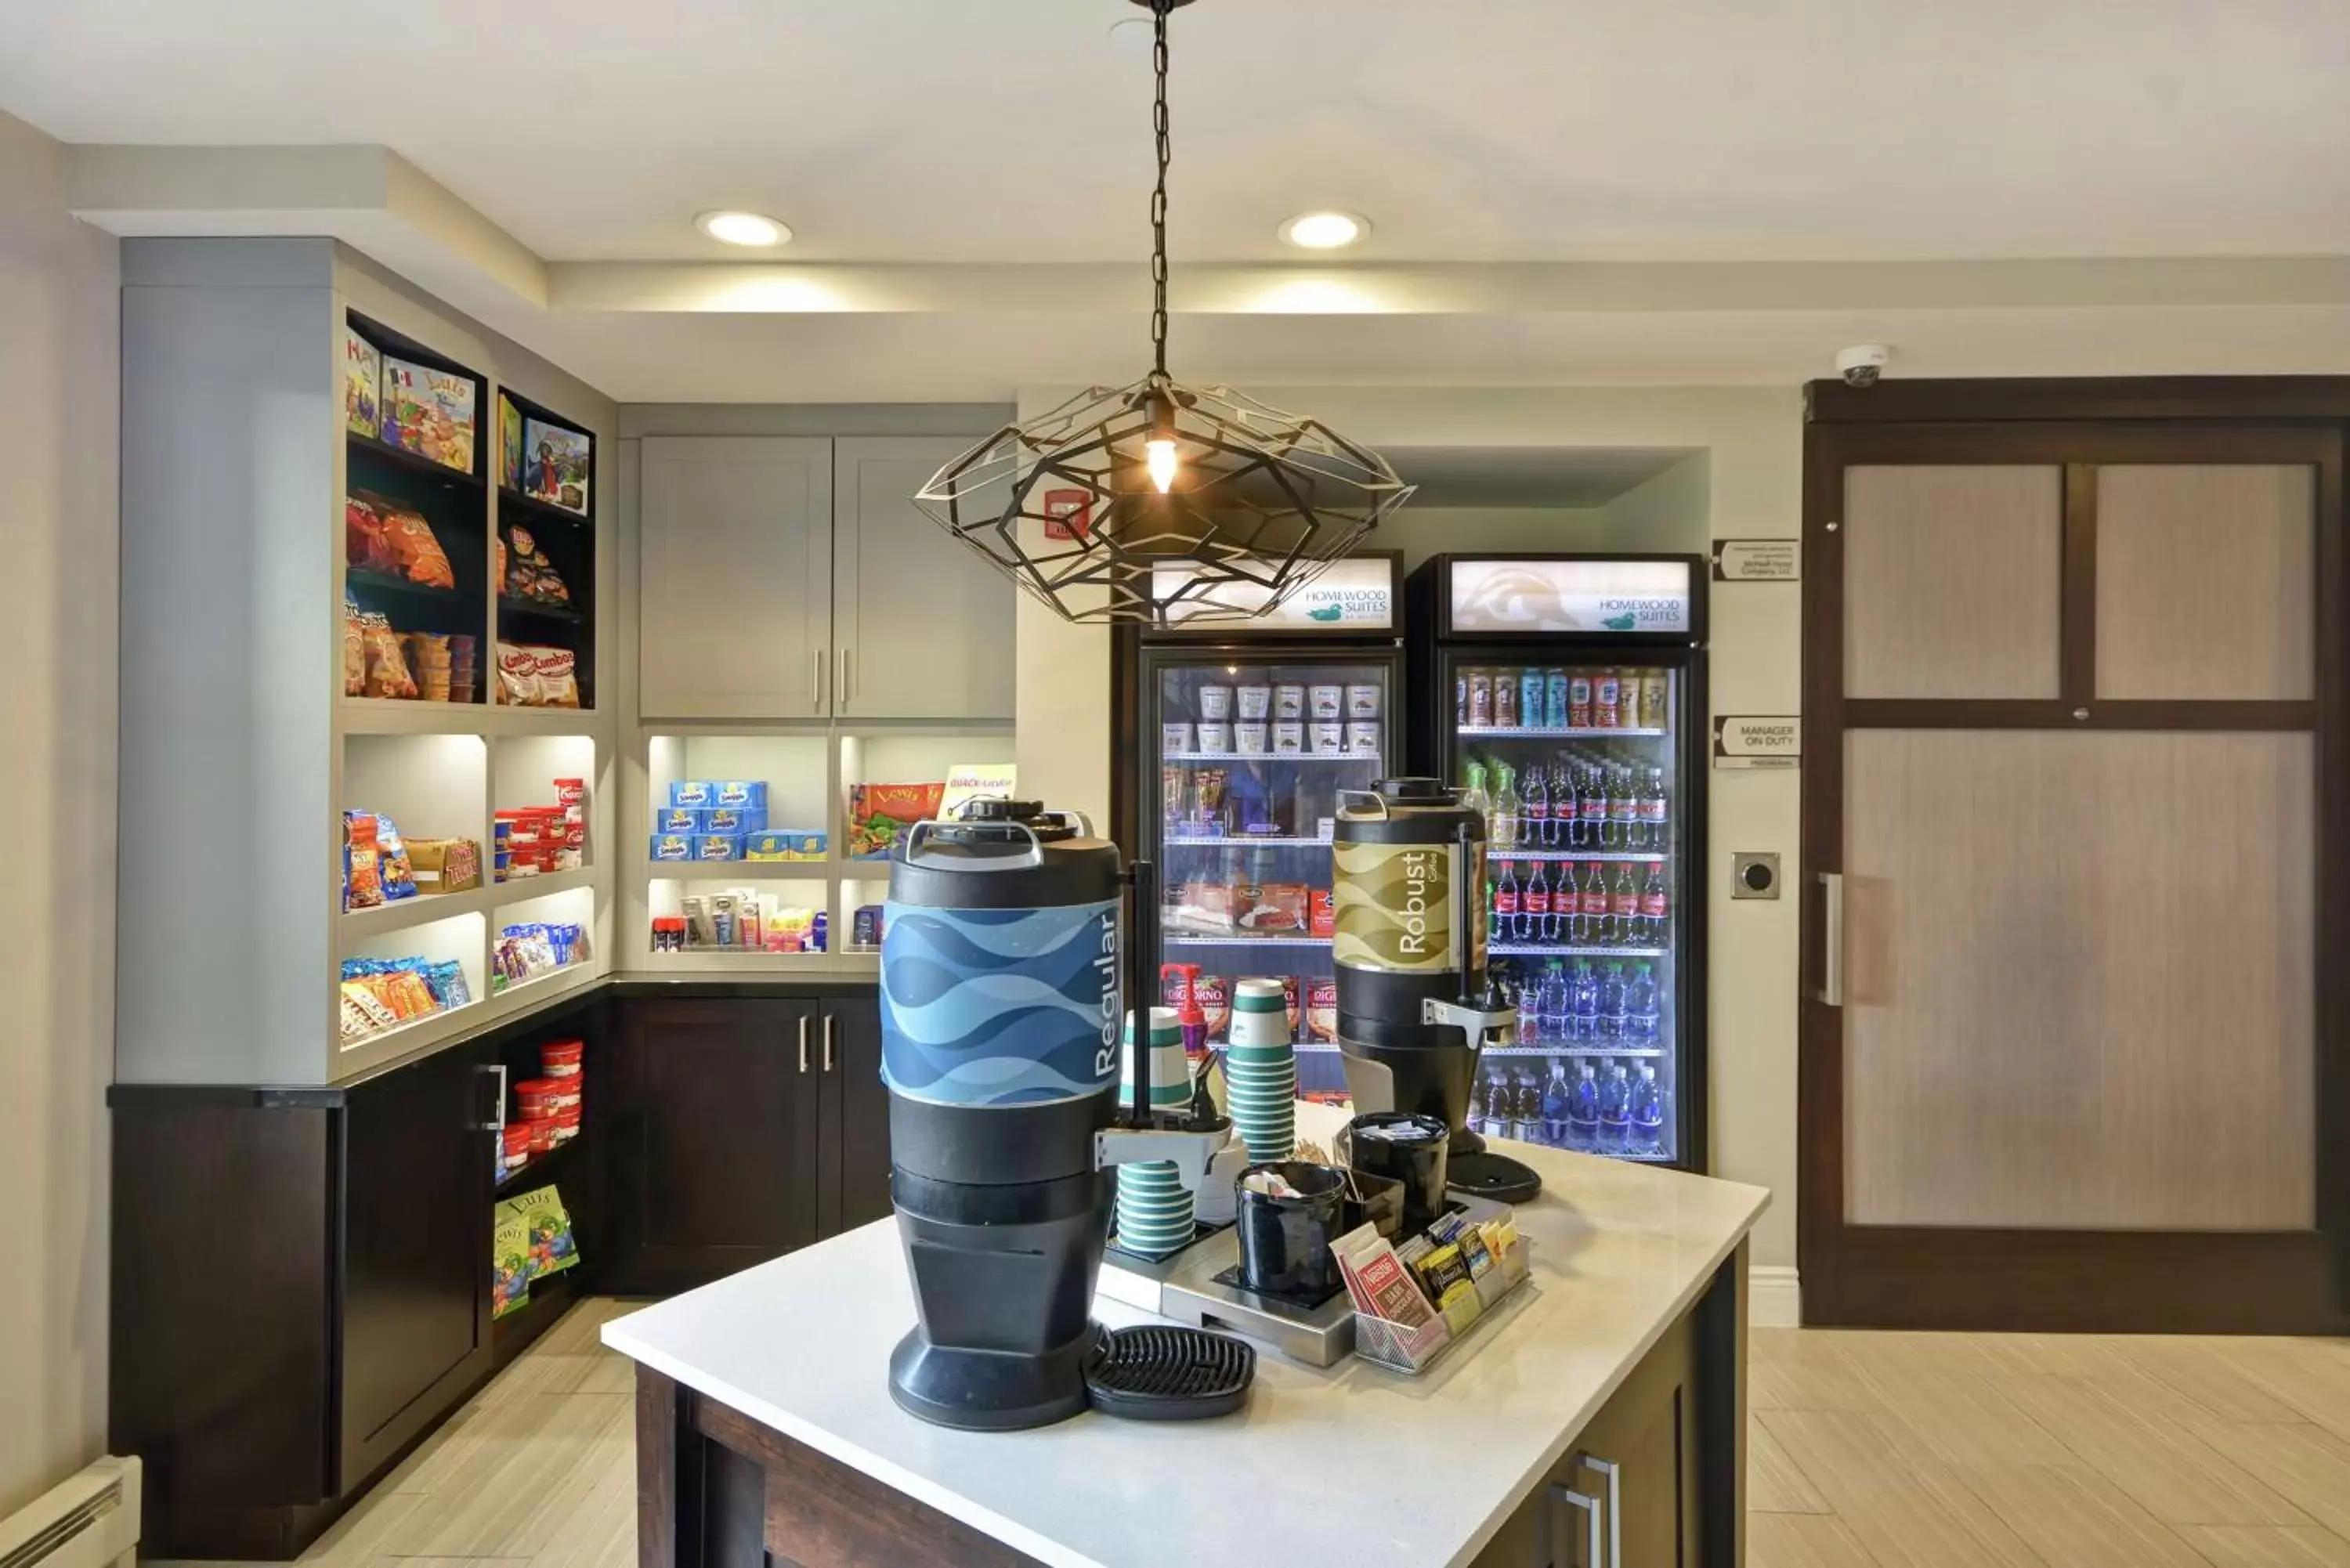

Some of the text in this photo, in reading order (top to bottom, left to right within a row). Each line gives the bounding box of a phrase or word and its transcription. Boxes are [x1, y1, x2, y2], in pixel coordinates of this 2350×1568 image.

[1306, 590, 1386, 602] HOMEWOOD
[1345, 602, 1386, 612] SUITES
[1600, 600, 1680, 610] HOMEWOOD
[1639, 611, 1680, 622] SUITES
[1741, 725, 1794, 735] MANAGER
[1745, 736, 1792, 746] ON DUTY
[877, 787, 919, 803] Lewis
[1428, 853, 1439, 883] Coffee
[1400, 852, 1426, 954] Robust
[1094, 914, 1119, 1077] Regular
[1169, 989, 1223, 1001] DIGORNO
